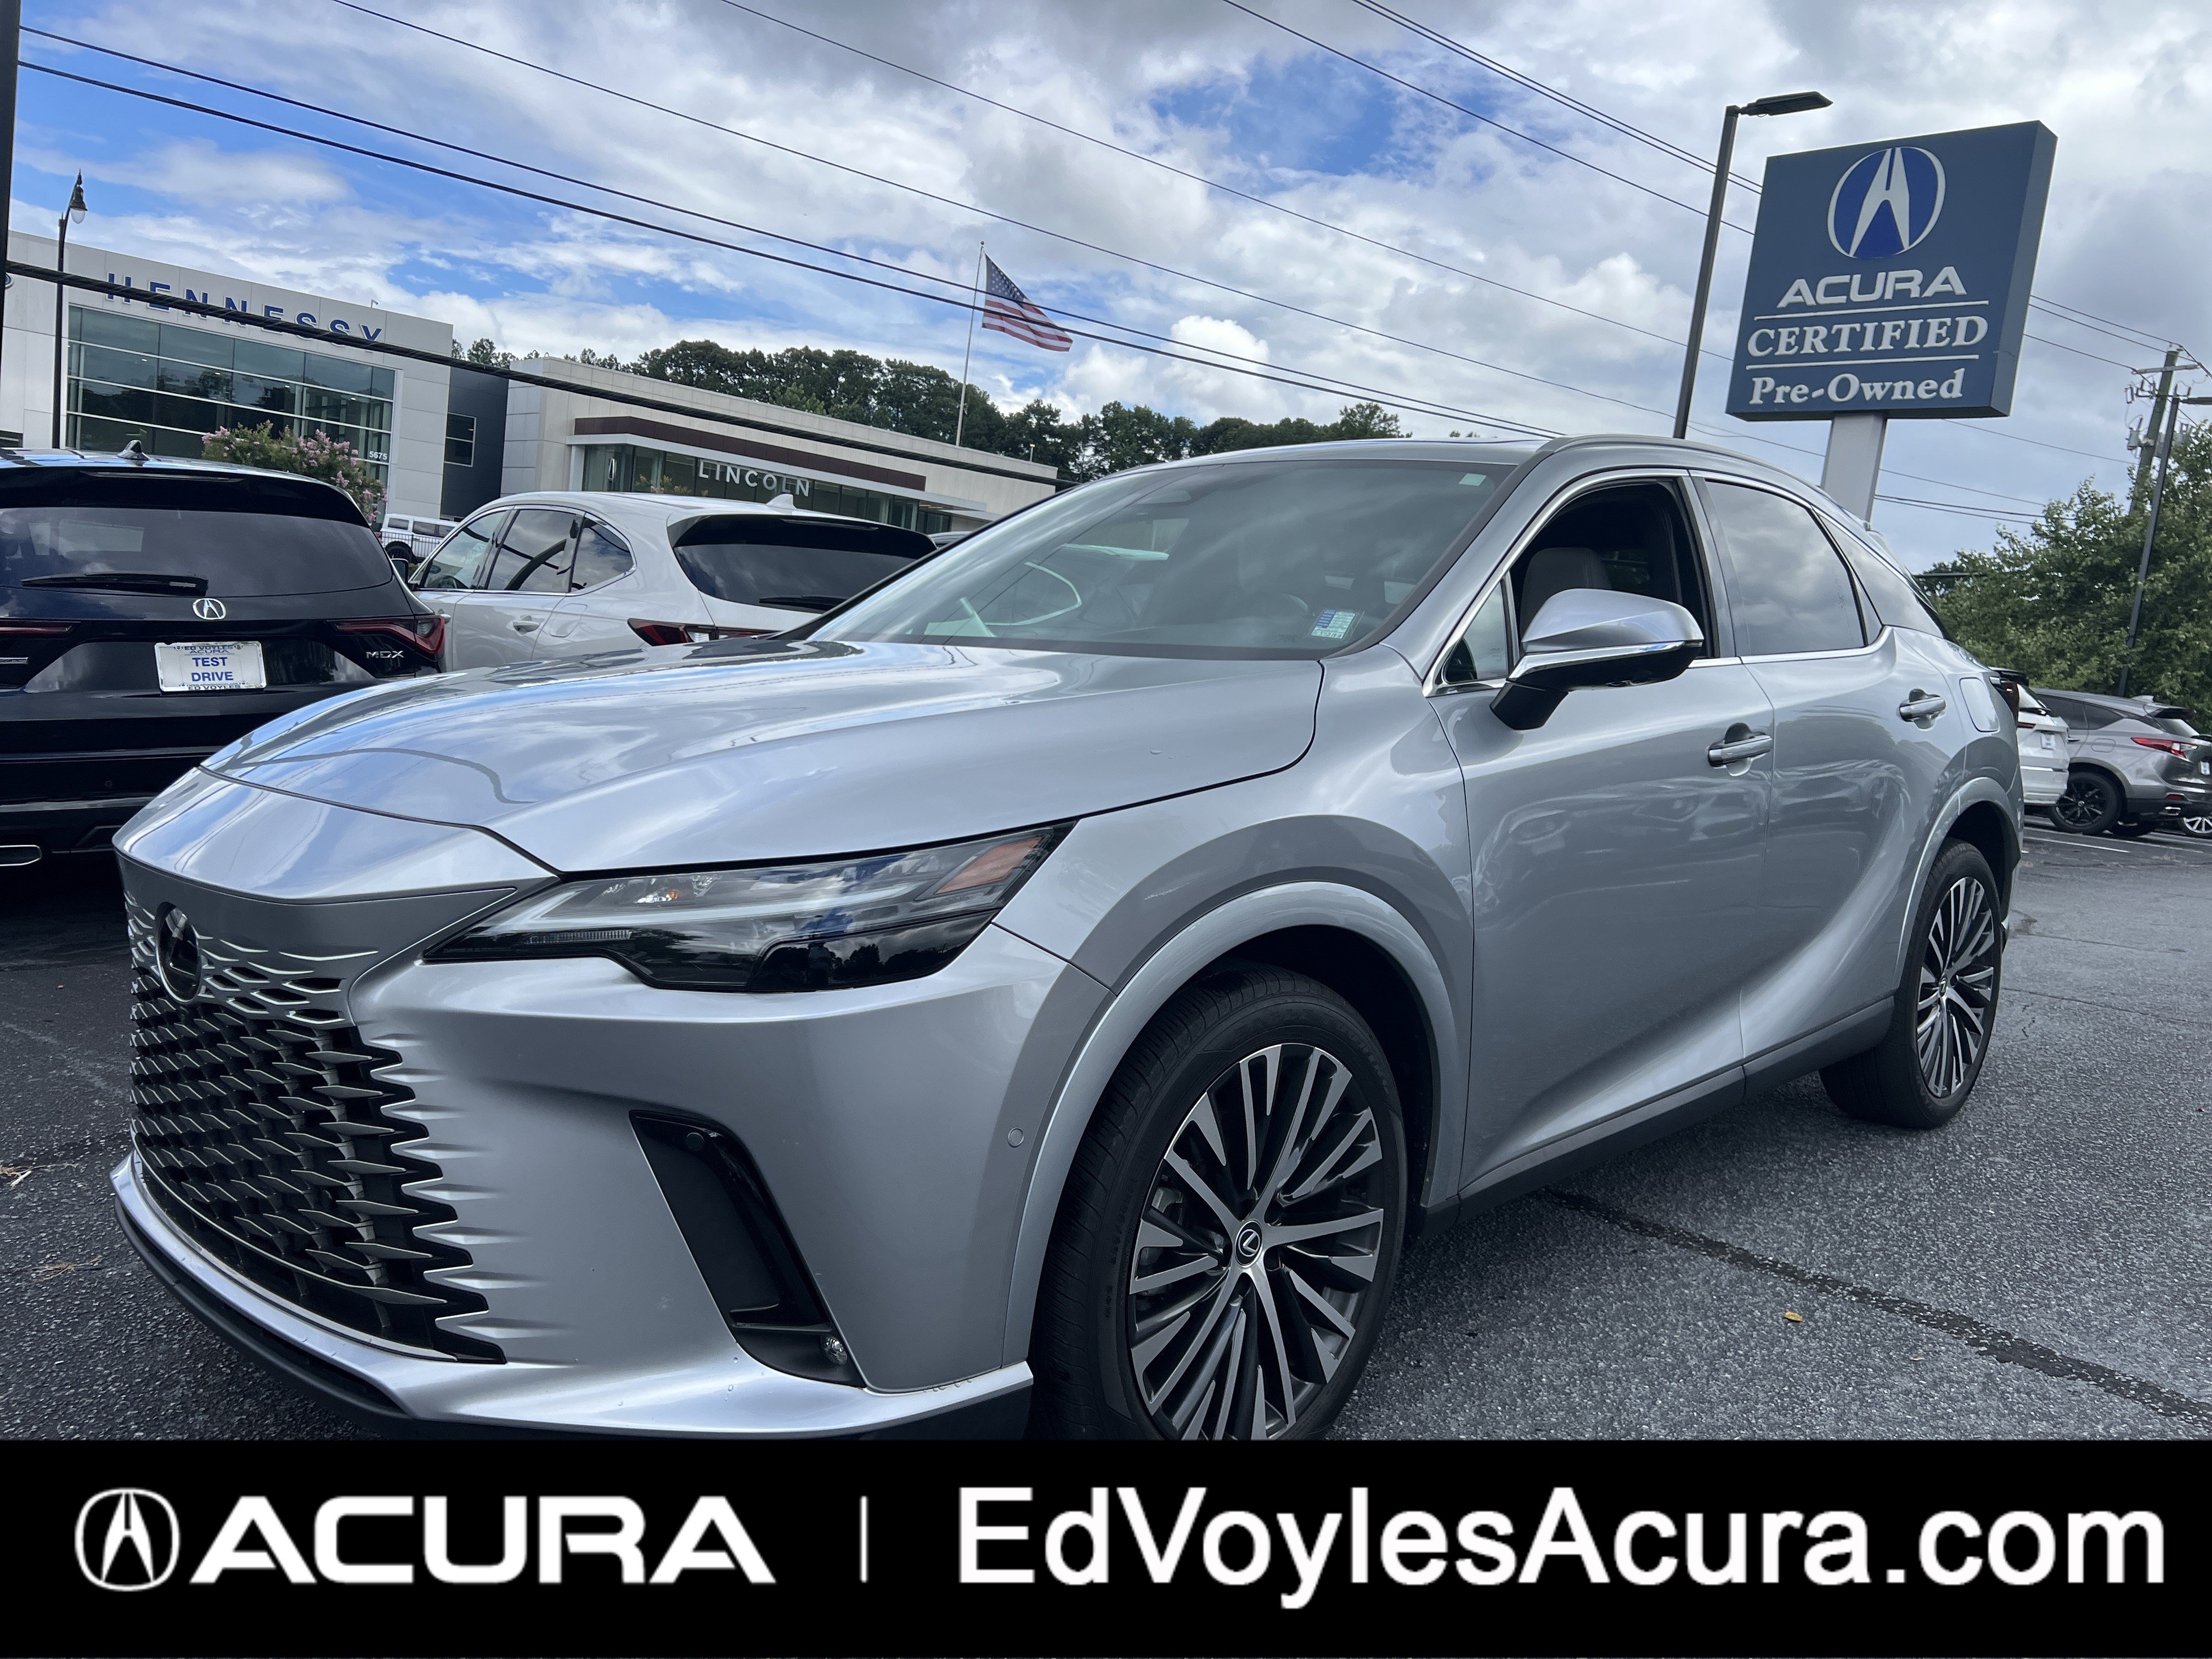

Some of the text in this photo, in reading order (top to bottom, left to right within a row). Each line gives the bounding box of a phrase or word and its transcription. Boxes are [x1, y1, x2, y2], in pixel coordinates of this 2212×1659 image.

[1776, 266, 1967, 309] ACURA
[1747, 315, 1989, 358] CERTIFIED
[1748, 368, 1965, 405] Pre-Owned
[369, 450, 388, 460] 5675
[699, 459, 810, 497] LINCOLN
[192, 657, 228, 667] TEST
[366, 650, 404, 659] MDX
[191, 672, 234, 682] DRIVE
